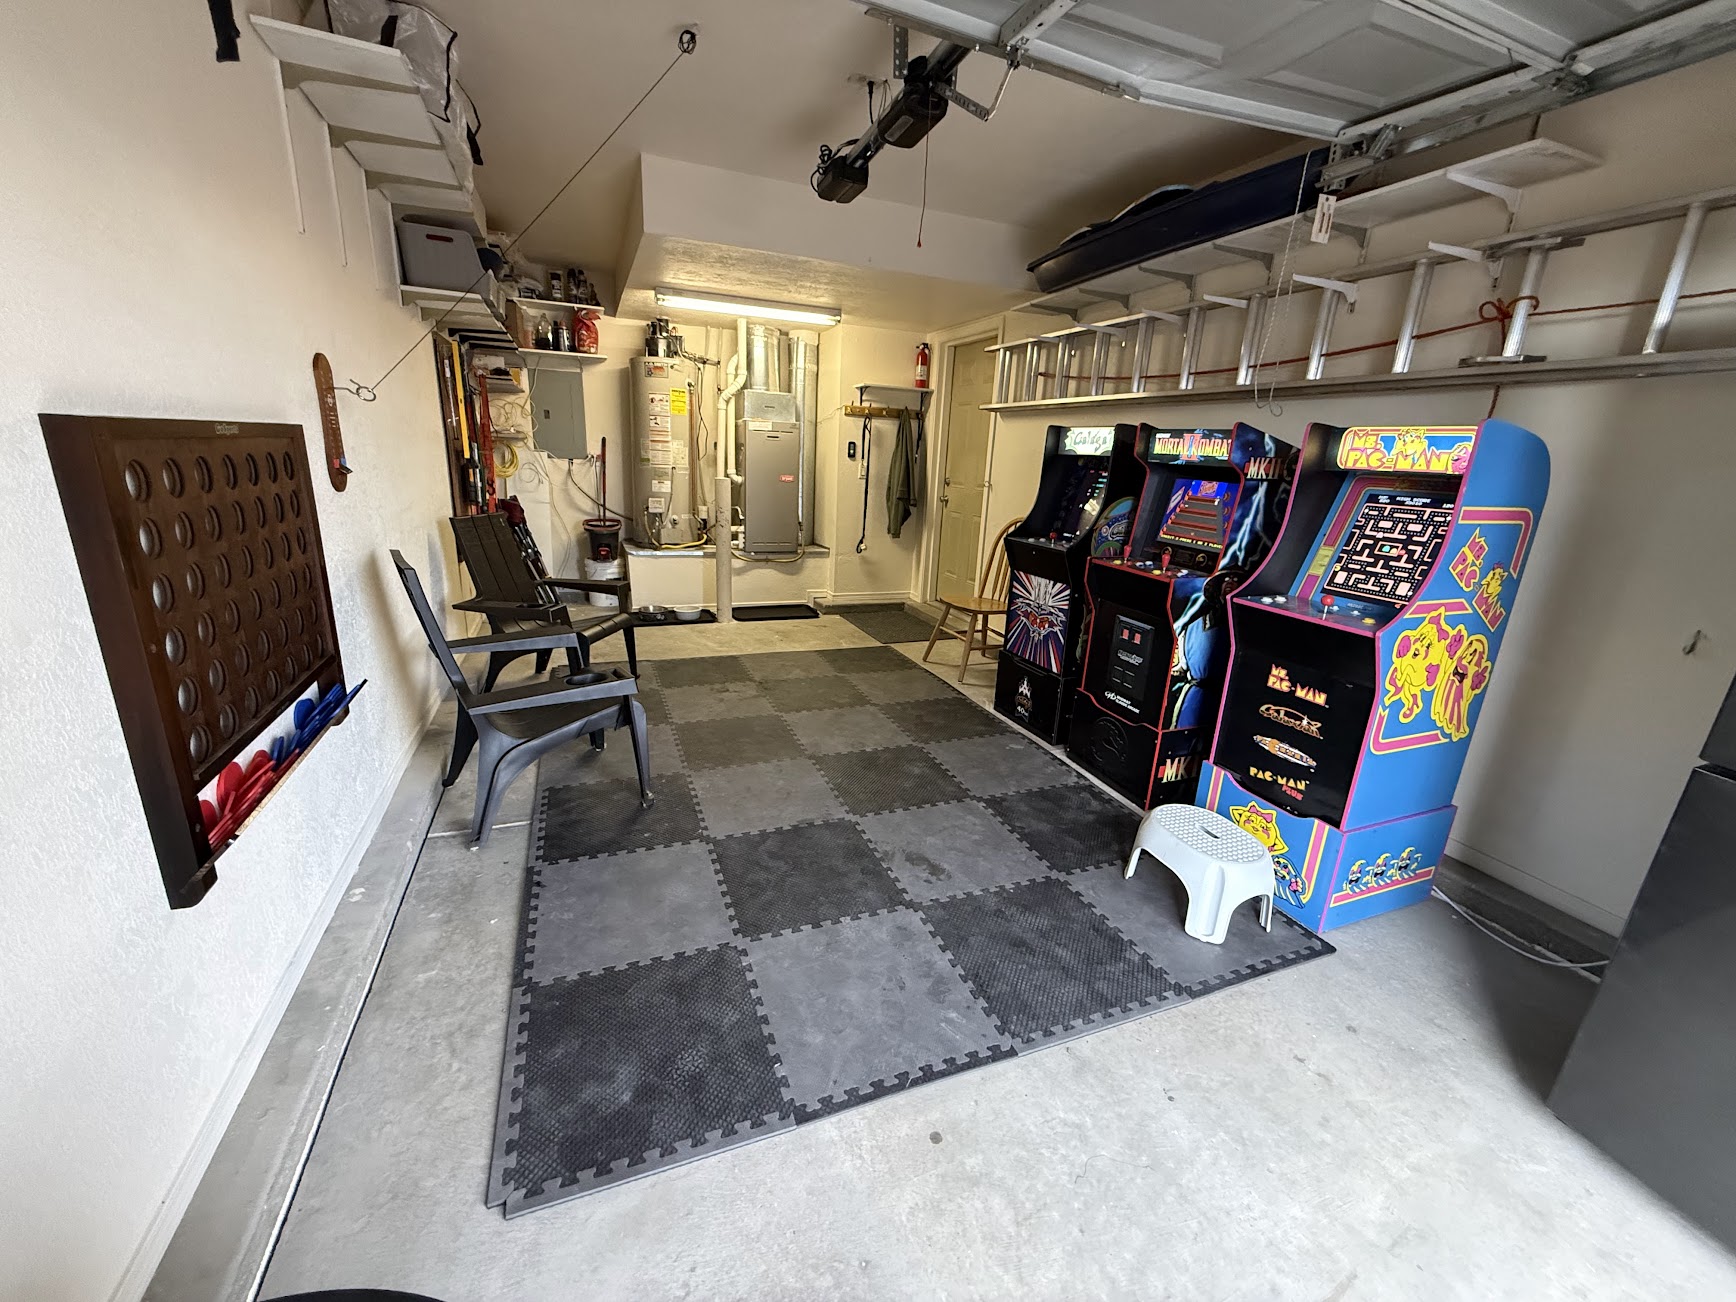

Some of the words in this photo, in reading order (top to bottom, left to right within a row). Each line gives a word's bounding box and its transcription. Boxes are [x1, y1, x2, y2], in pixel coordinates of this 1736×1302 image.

[1073, 430, 1107, 453] Galaga
[1344, 447, 1450, 473] PAC-MAN
[1267, 674, 1328, 707] PAC-MAN
[1249, 766, 1306, 791] PAC-MAN
